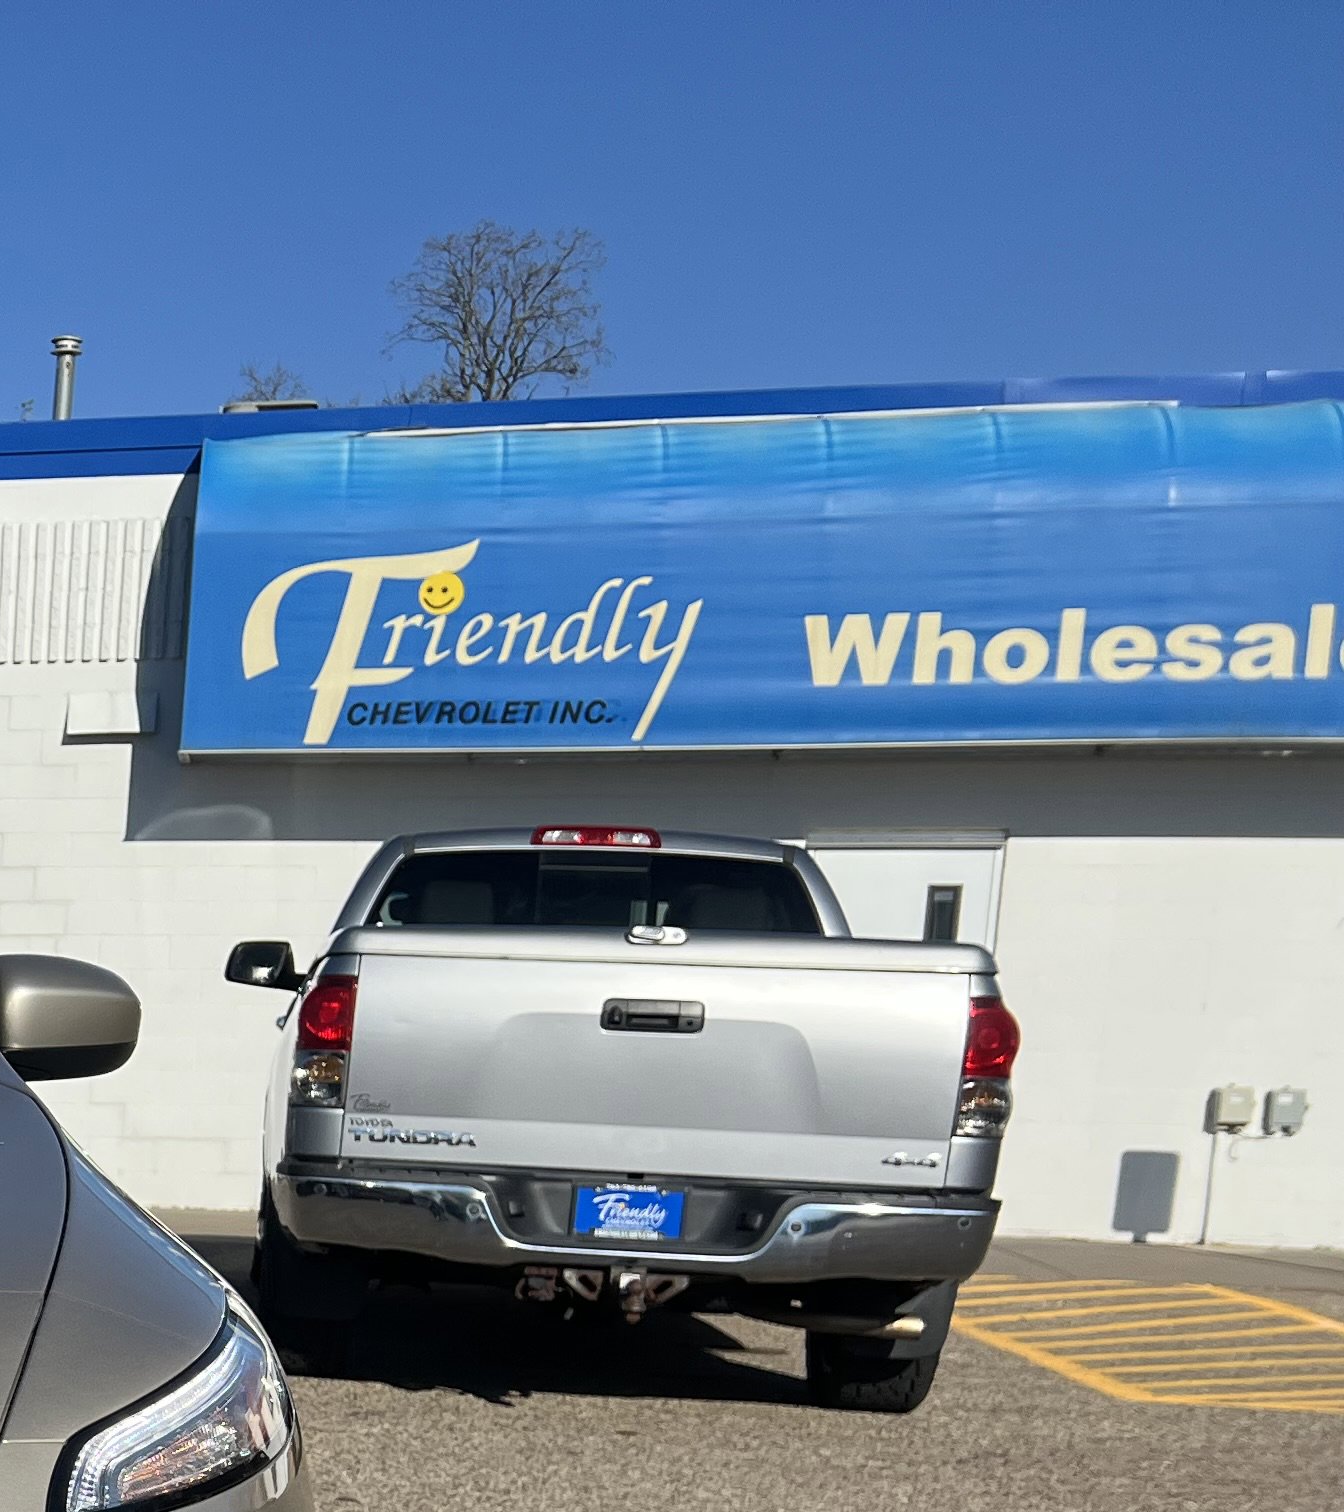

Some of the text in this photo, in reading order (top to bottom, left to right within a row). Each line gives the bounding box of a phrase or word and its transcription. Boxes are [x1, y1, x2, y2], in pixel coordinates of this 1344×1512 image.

[241, 538, 704, 745] Friendly
[804, 603, 1344, 686] Wholesal
[346, 700, 541, 727] CHEVROLET
[348, 1126, 477, 1147] TUNDRA
[593, 1192, 668, 1229] Friendly
